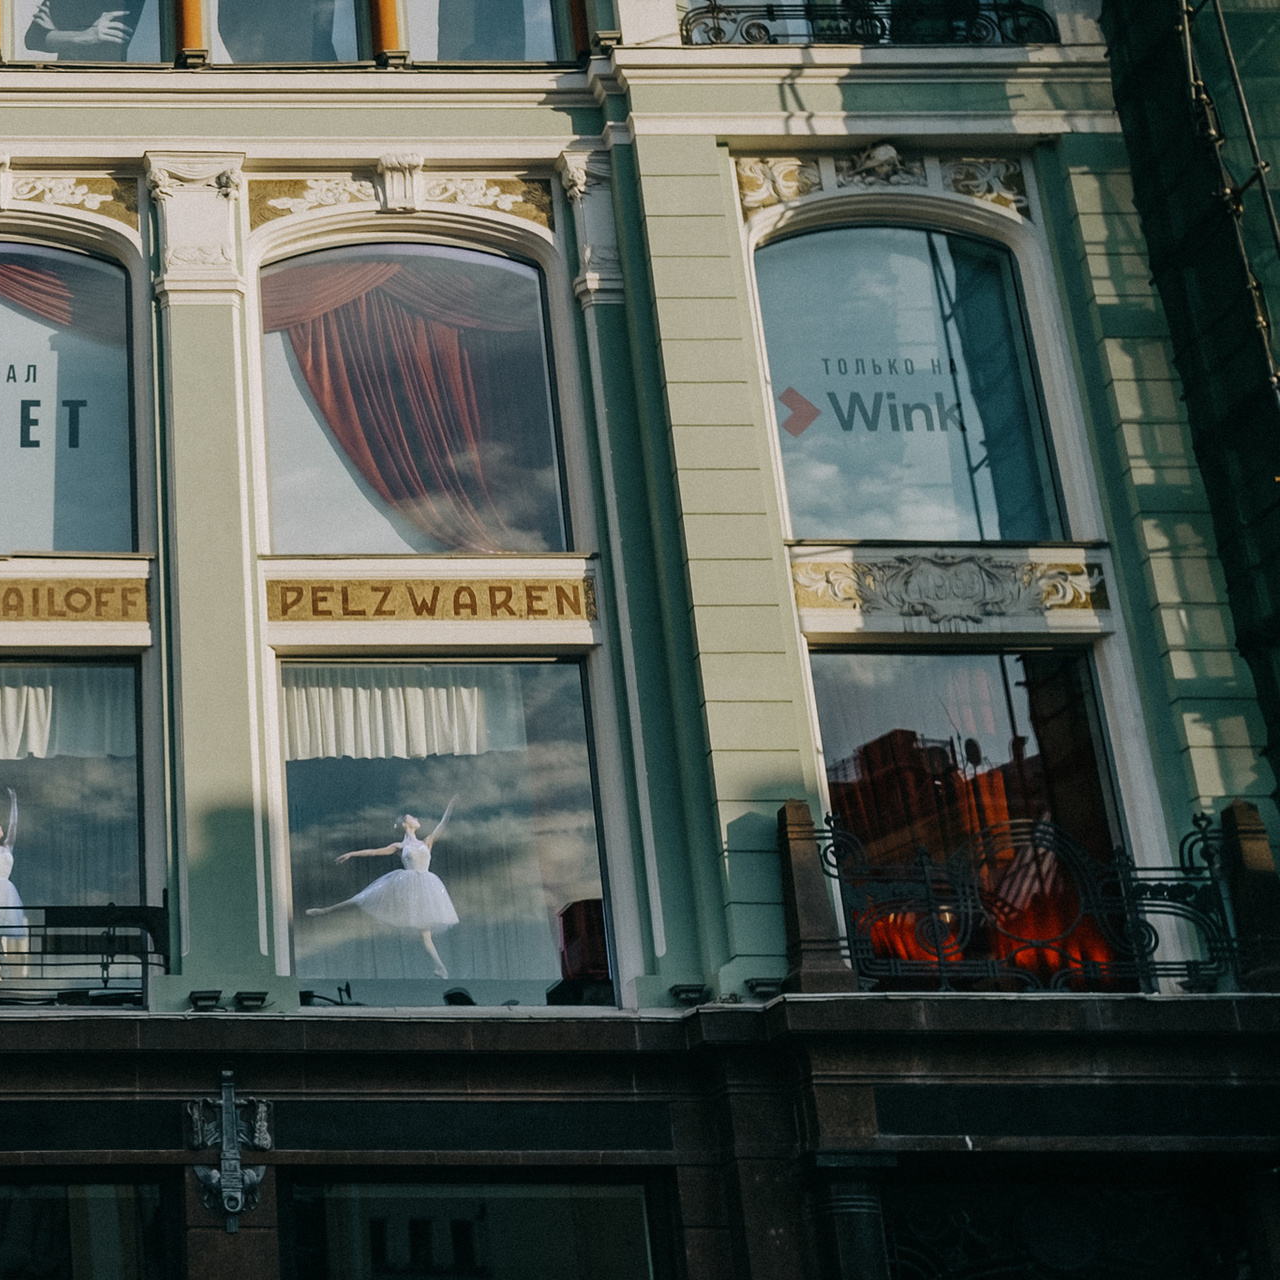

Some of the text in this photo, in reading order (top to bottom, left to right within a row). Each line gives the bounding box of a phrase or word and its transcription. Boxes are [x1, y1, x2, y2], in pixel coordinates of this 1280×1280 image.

[821, 358, 959, 376] ТОЛЬКО НА
[826, 391, 967, 432] Wink
[280, 585, 582, 617] PELZWAREN
